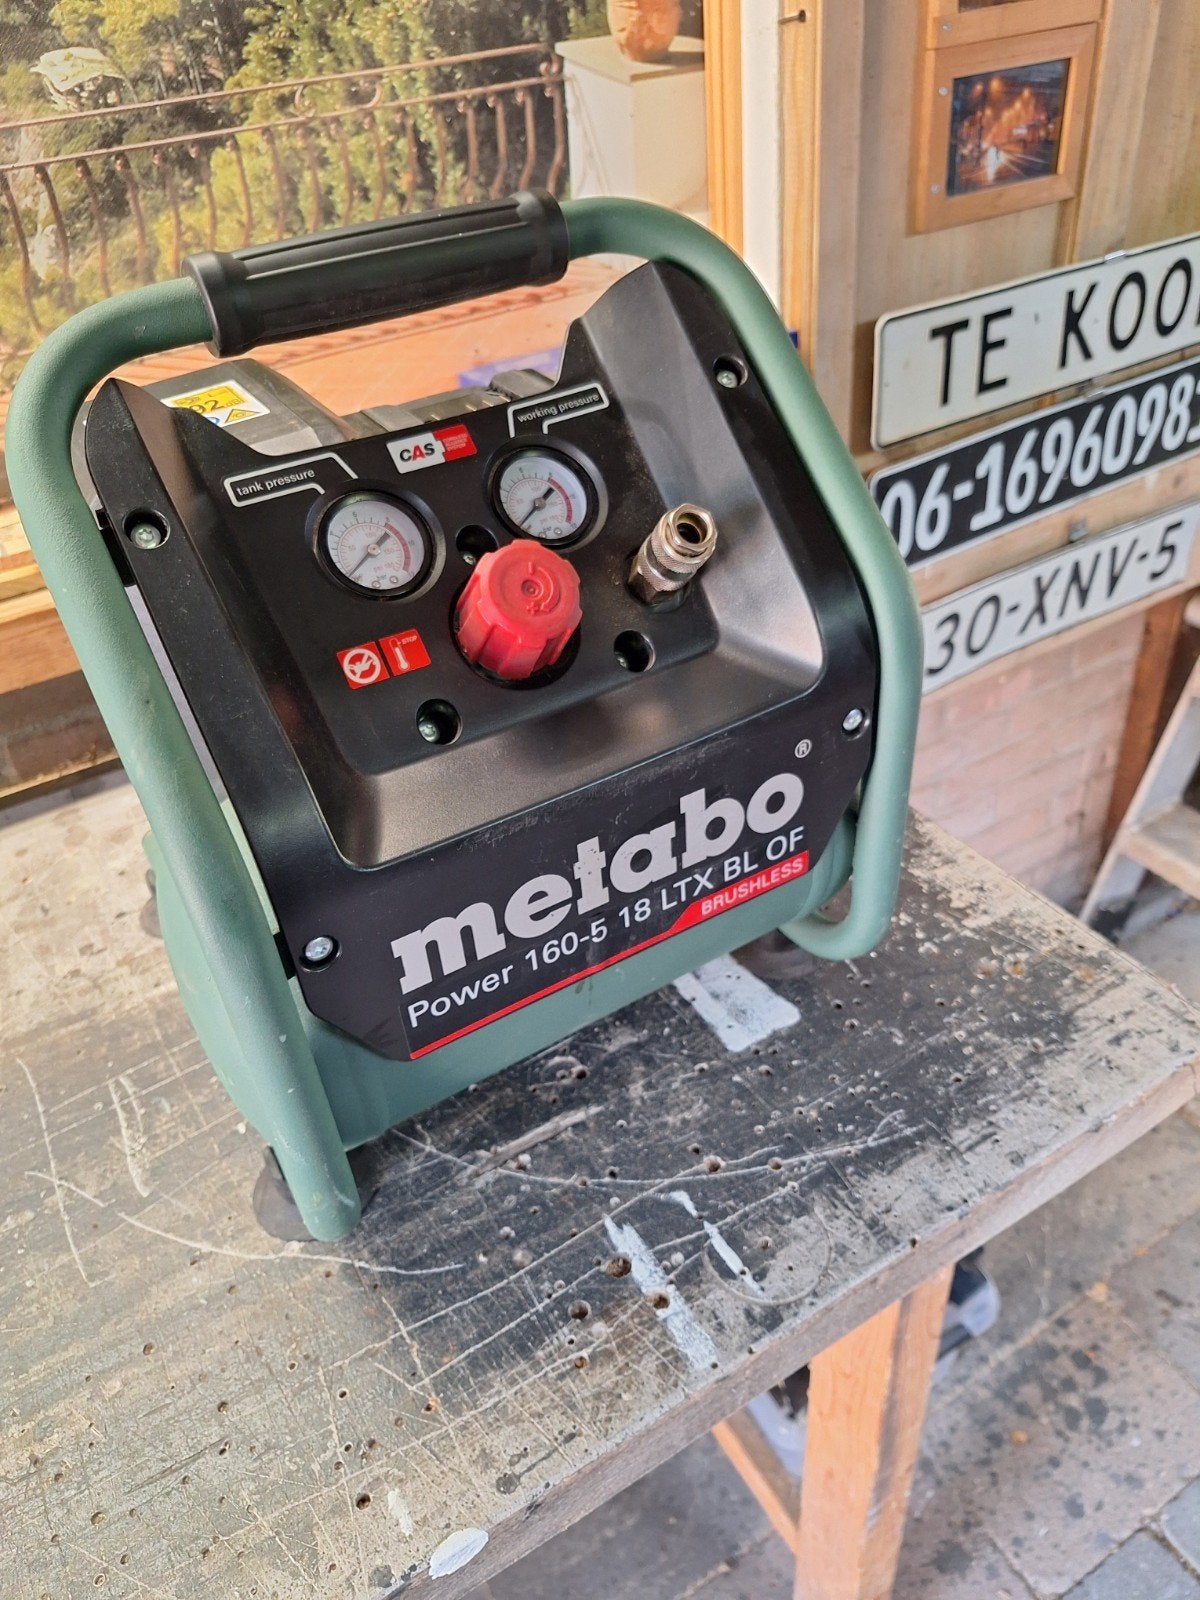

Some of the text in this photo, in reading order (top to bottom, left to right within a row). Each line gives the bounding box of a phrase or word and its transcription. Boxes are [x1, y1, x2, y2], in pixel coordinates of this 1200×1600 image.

[929, 257, 1200, 407] TE KOO
[236, 468, 316, 497] tank pressure
[399, 442, 436, 462] CAS
[517, 393, 600, 423] working pressure
[880, 372, 1200, 559] 06-1696098
[925, 520, 1184, 676] 30-XNV-5
[390, 772, 804, 995] metabo
[407, 825, 805, 1028] Power 160-5 18 LTX BL OF
[701, 857, 804, 916] BRUSHLESS
